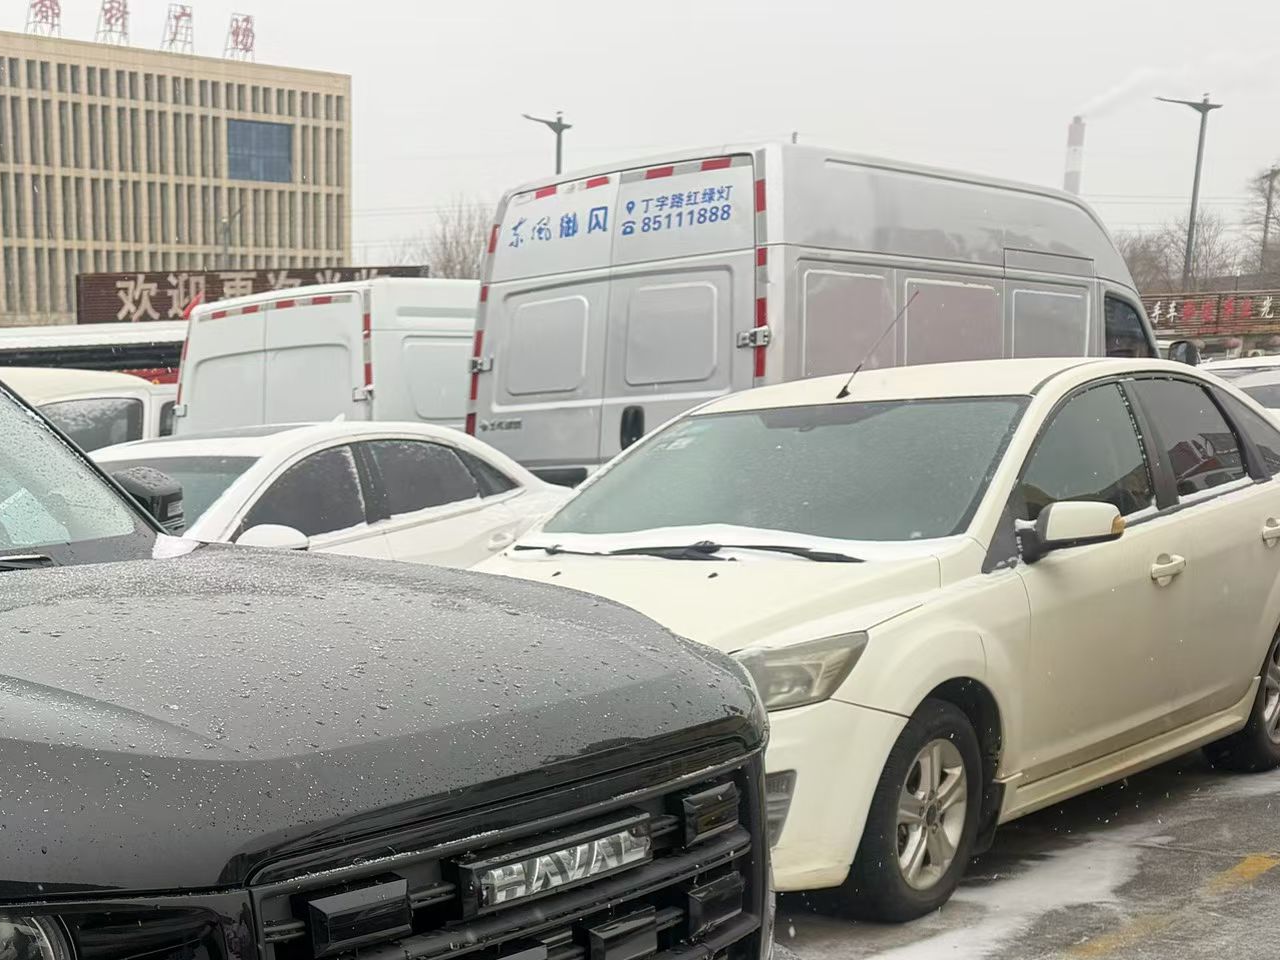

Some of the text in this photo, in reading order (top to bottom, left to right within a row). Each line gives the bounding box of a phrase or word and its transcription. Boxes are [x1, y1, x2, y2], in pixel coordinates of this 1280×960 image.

[641, 185, 733, 214] 丁字路红绿灯
[641, 204, 732, 233] 85111888
